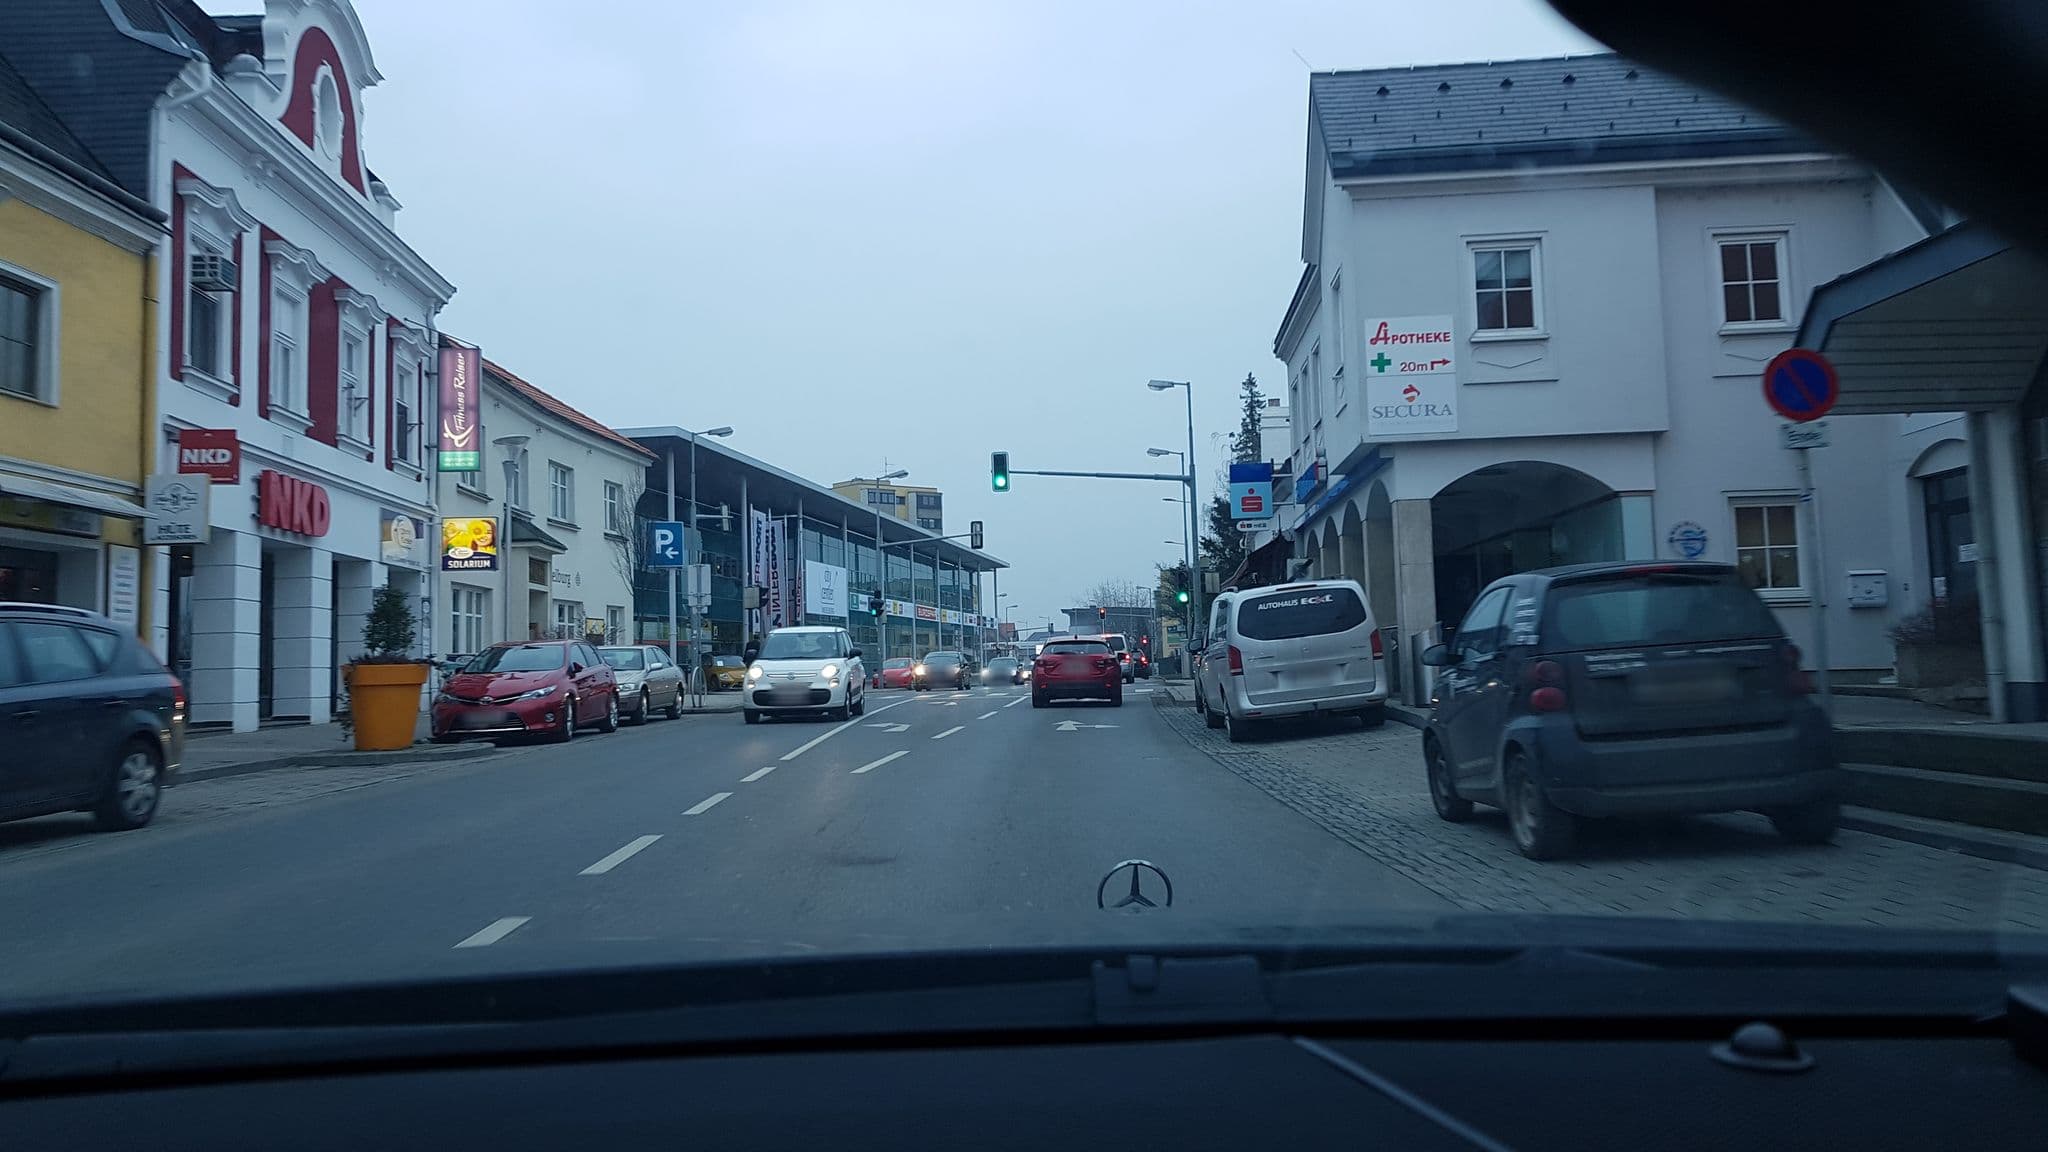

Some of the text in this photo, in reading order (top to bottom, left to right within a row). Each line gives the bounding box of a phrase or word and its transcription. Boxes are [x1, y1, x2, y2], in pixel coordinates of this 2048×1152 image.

[1370, 321, 1451, 345] APOTHEKE
[1400, 361, 1428, 372] 20m
[1372, 404, 1453, 419] SECURA
[182, 448, 232, 464] NKD
[262, 470, 330, 537] NKD
[655, 529, 674, 554] P
[448, 559, 491, 568] SOLARIUM
[1258, 599, 1298, 611] AUTOHAUS
